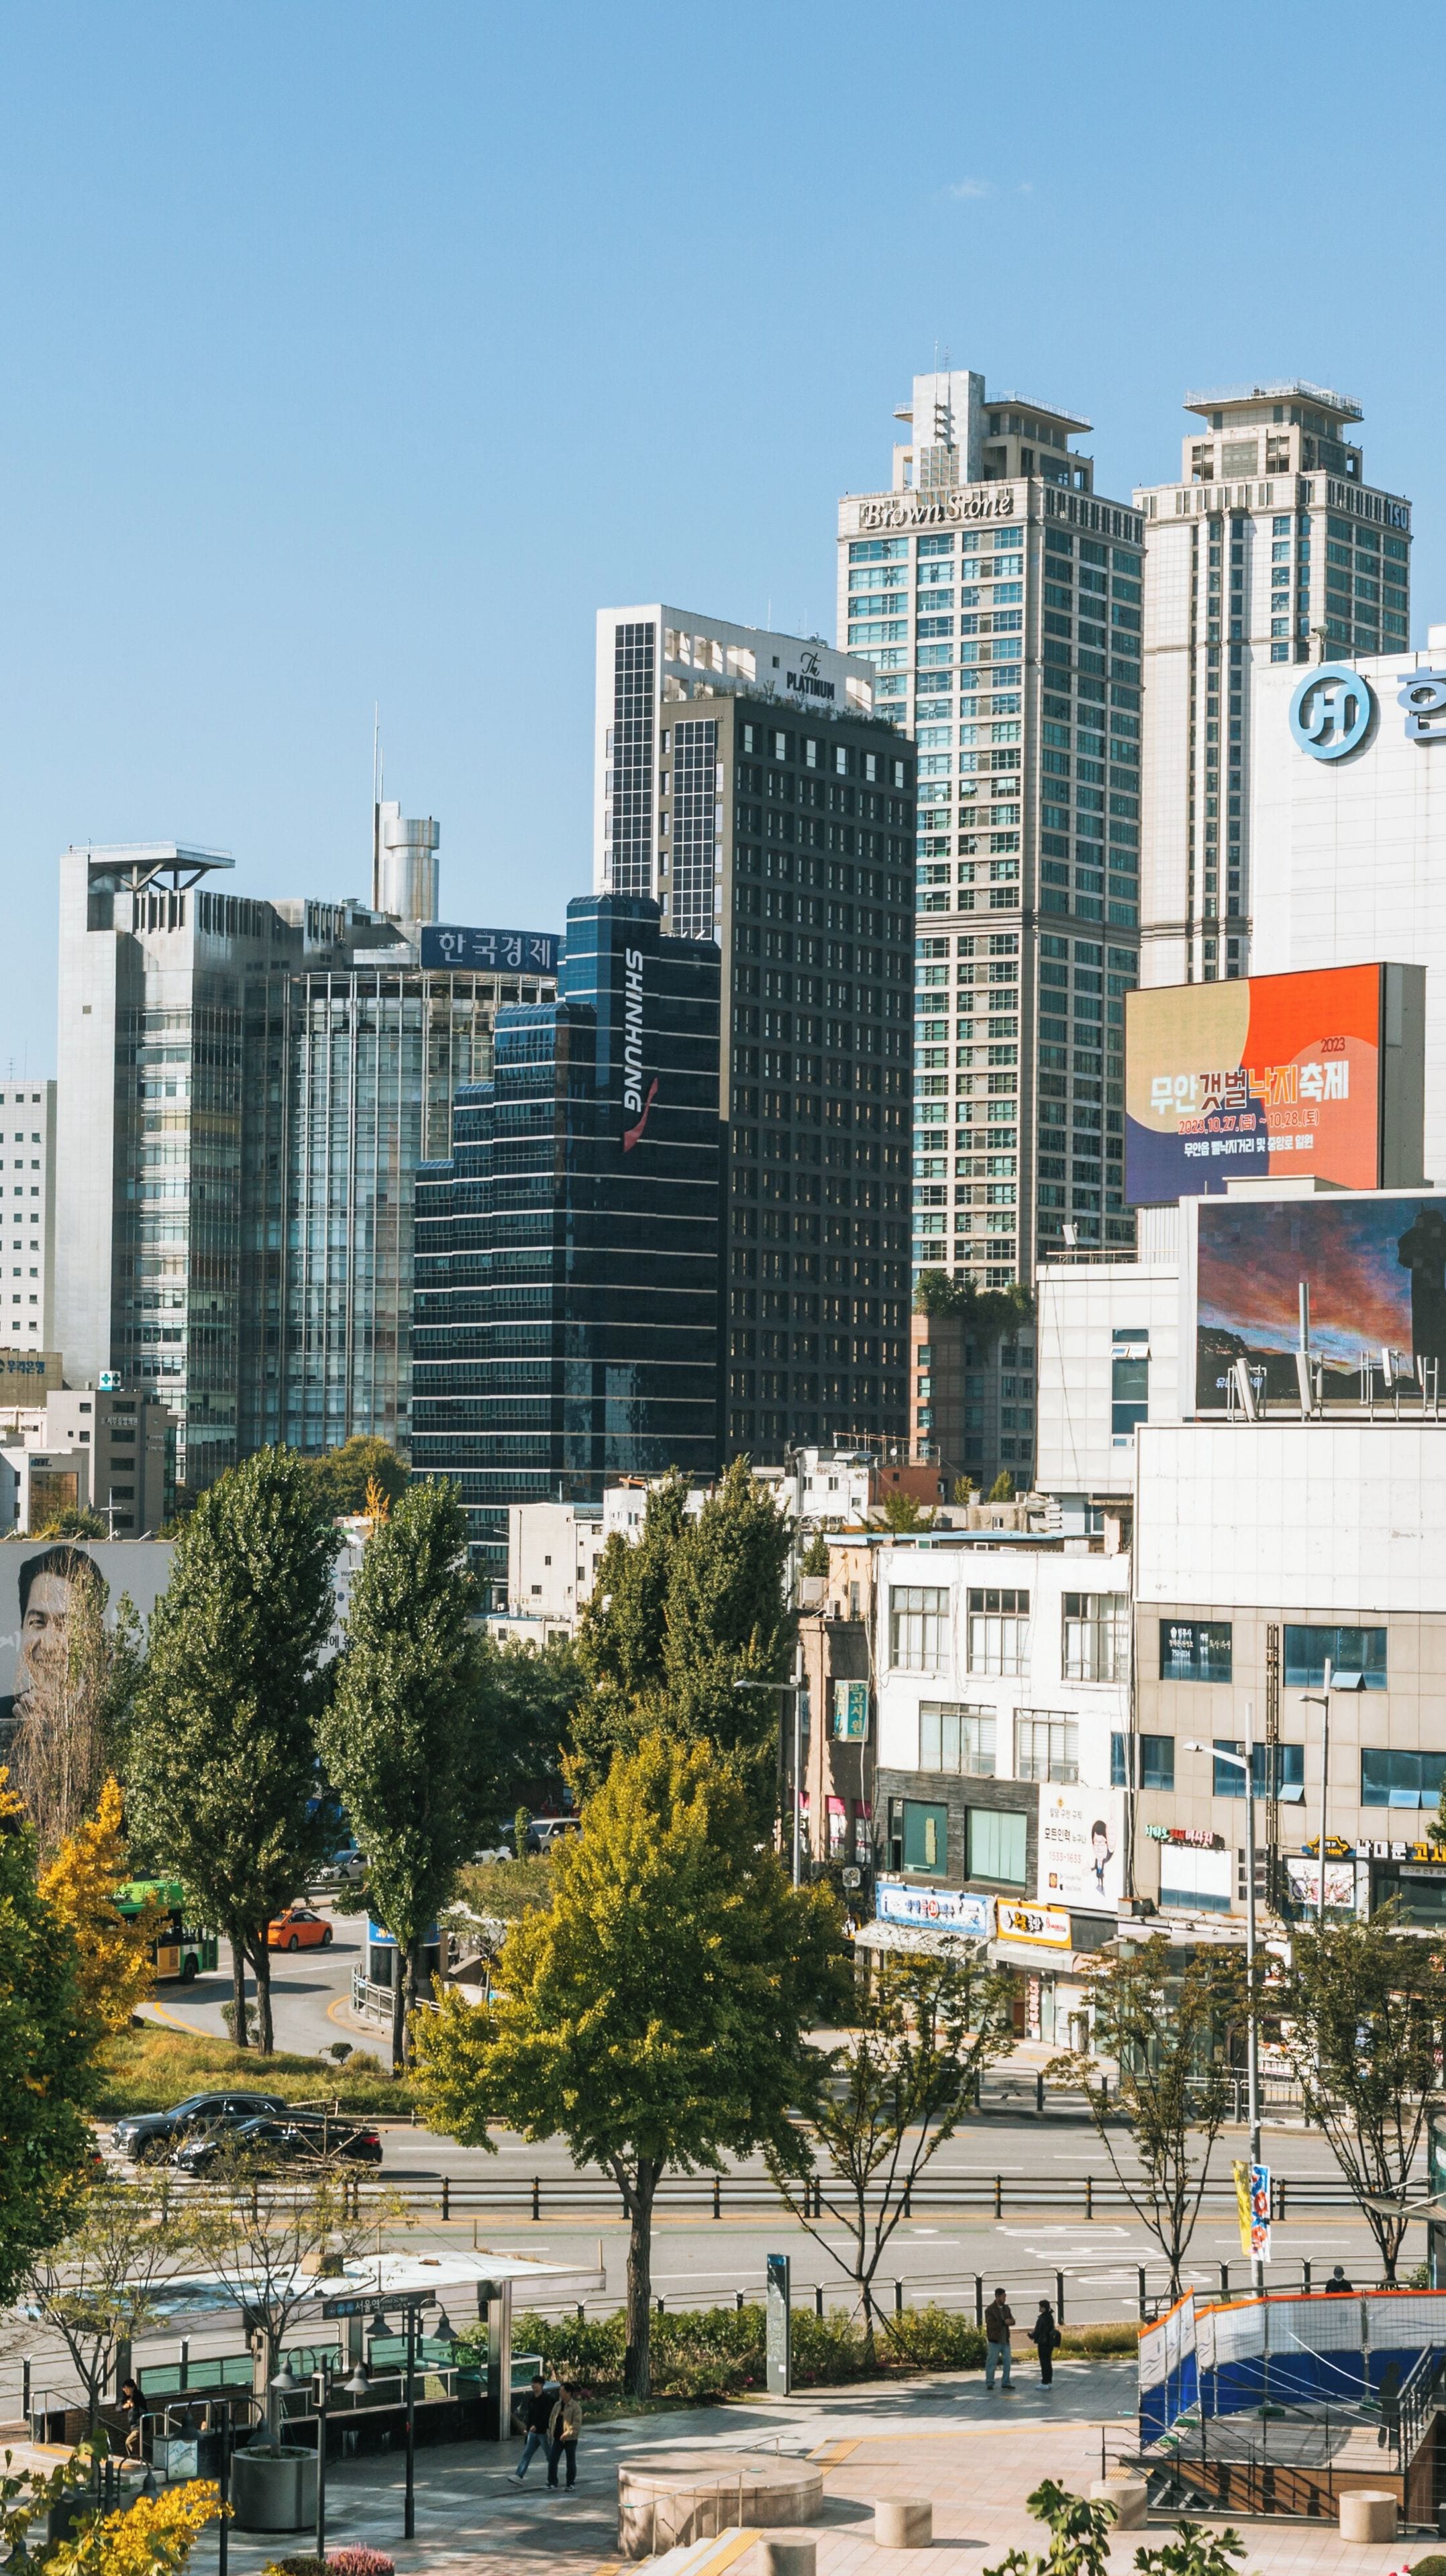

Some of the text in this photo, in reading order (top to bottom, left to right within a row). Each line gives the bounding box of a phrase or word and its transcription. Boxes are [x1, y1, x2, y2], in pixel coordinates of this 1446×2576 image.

[862, 494, 1011, 527] Brown Stone
[1390, 502, 1408, 530] ISU
[801, 651, 821, 677] The
[787, 671, 835, 700] PLATINUM
[439, 932, 550, 969] 한국경제
[624, 948, 643, 1113] SHINHUNG
[1321, 1037, 1346, 1053] 2023
[851, 1692, 864, 1733] 고시원
[1045, 1827, 1071, 1843] 모든인력
[1356, 1839, 1406, 1861] 남대문
[355, 2298, 380, 2313] 서울역
